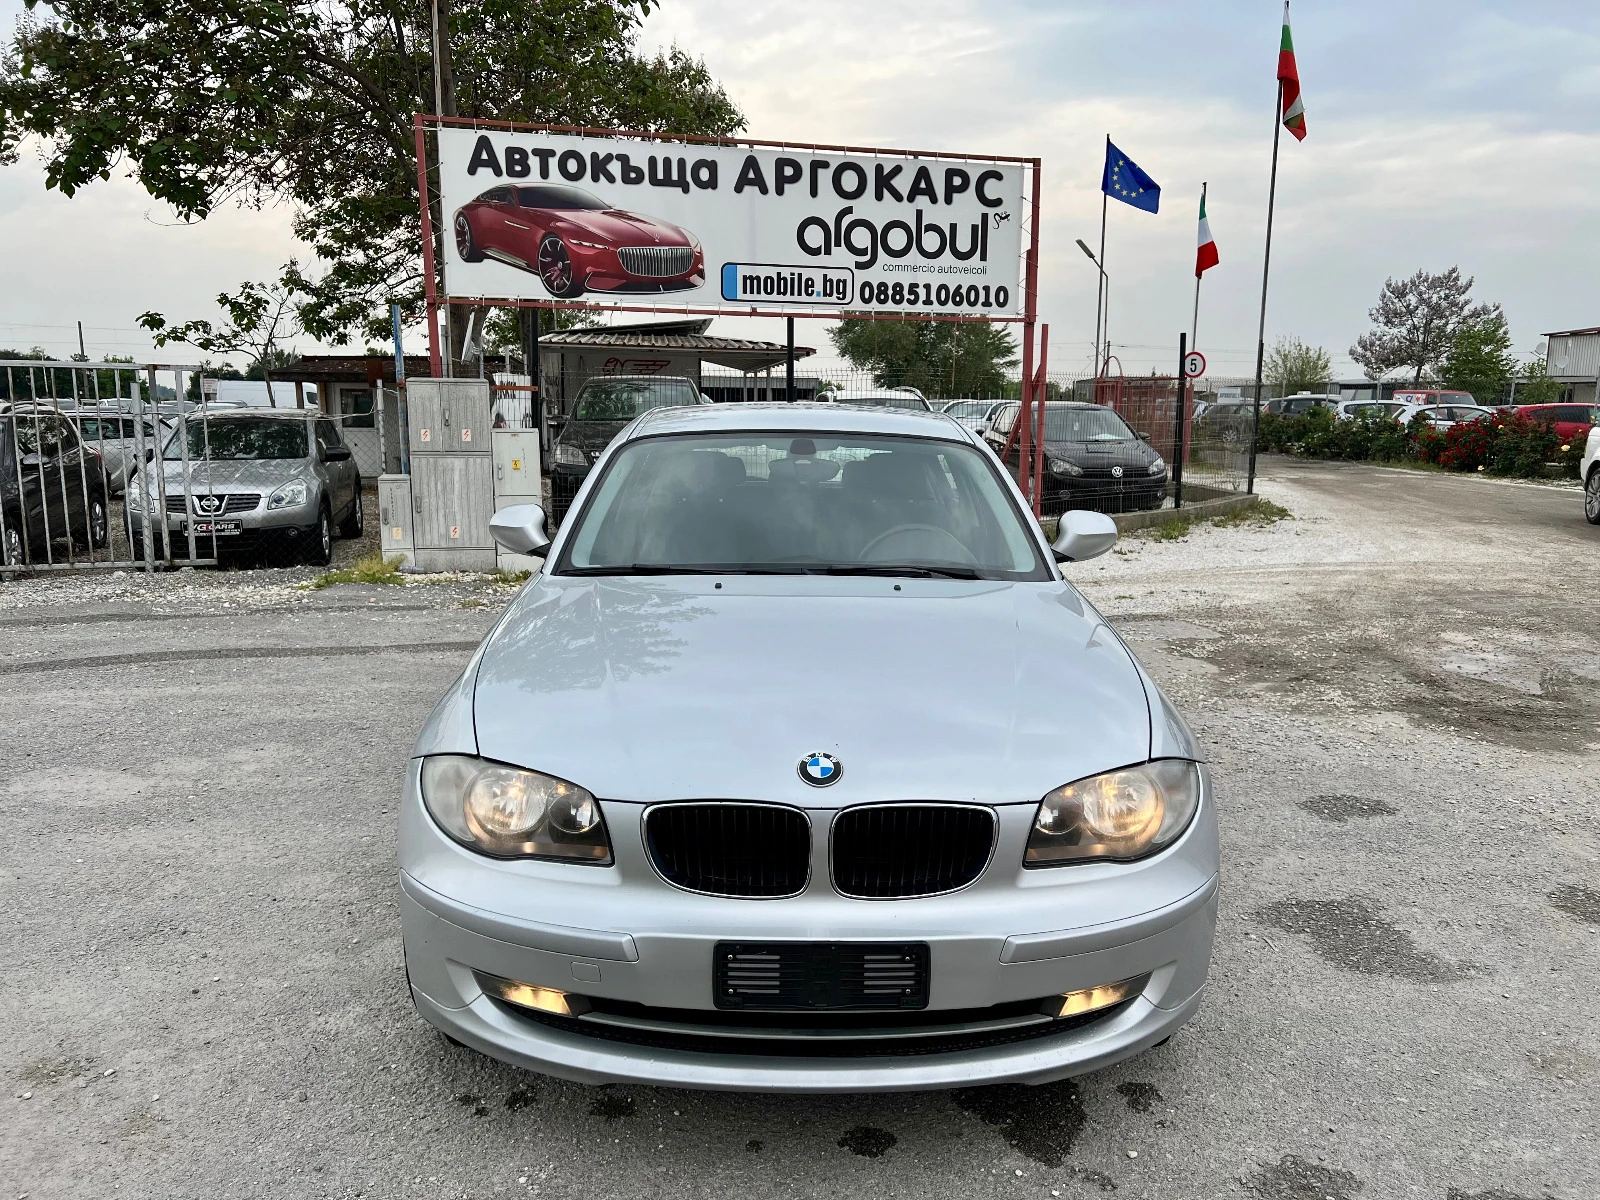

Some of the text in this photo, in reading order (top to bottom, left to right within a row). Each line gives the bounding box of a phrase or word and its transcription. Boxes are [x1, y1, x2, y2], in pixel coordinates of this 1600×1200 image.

[467, 135, 1003, 208] Автокъща АРГОКАРС
[797, 206, 988, 270] argobul
[882, 263, 987, 275] commercio autoveicoli
[742, 272, 848, 300] mobile.bg
[859, 281, 1009, 308] 0885106010
[1190, 358, 1197, 373] 5
